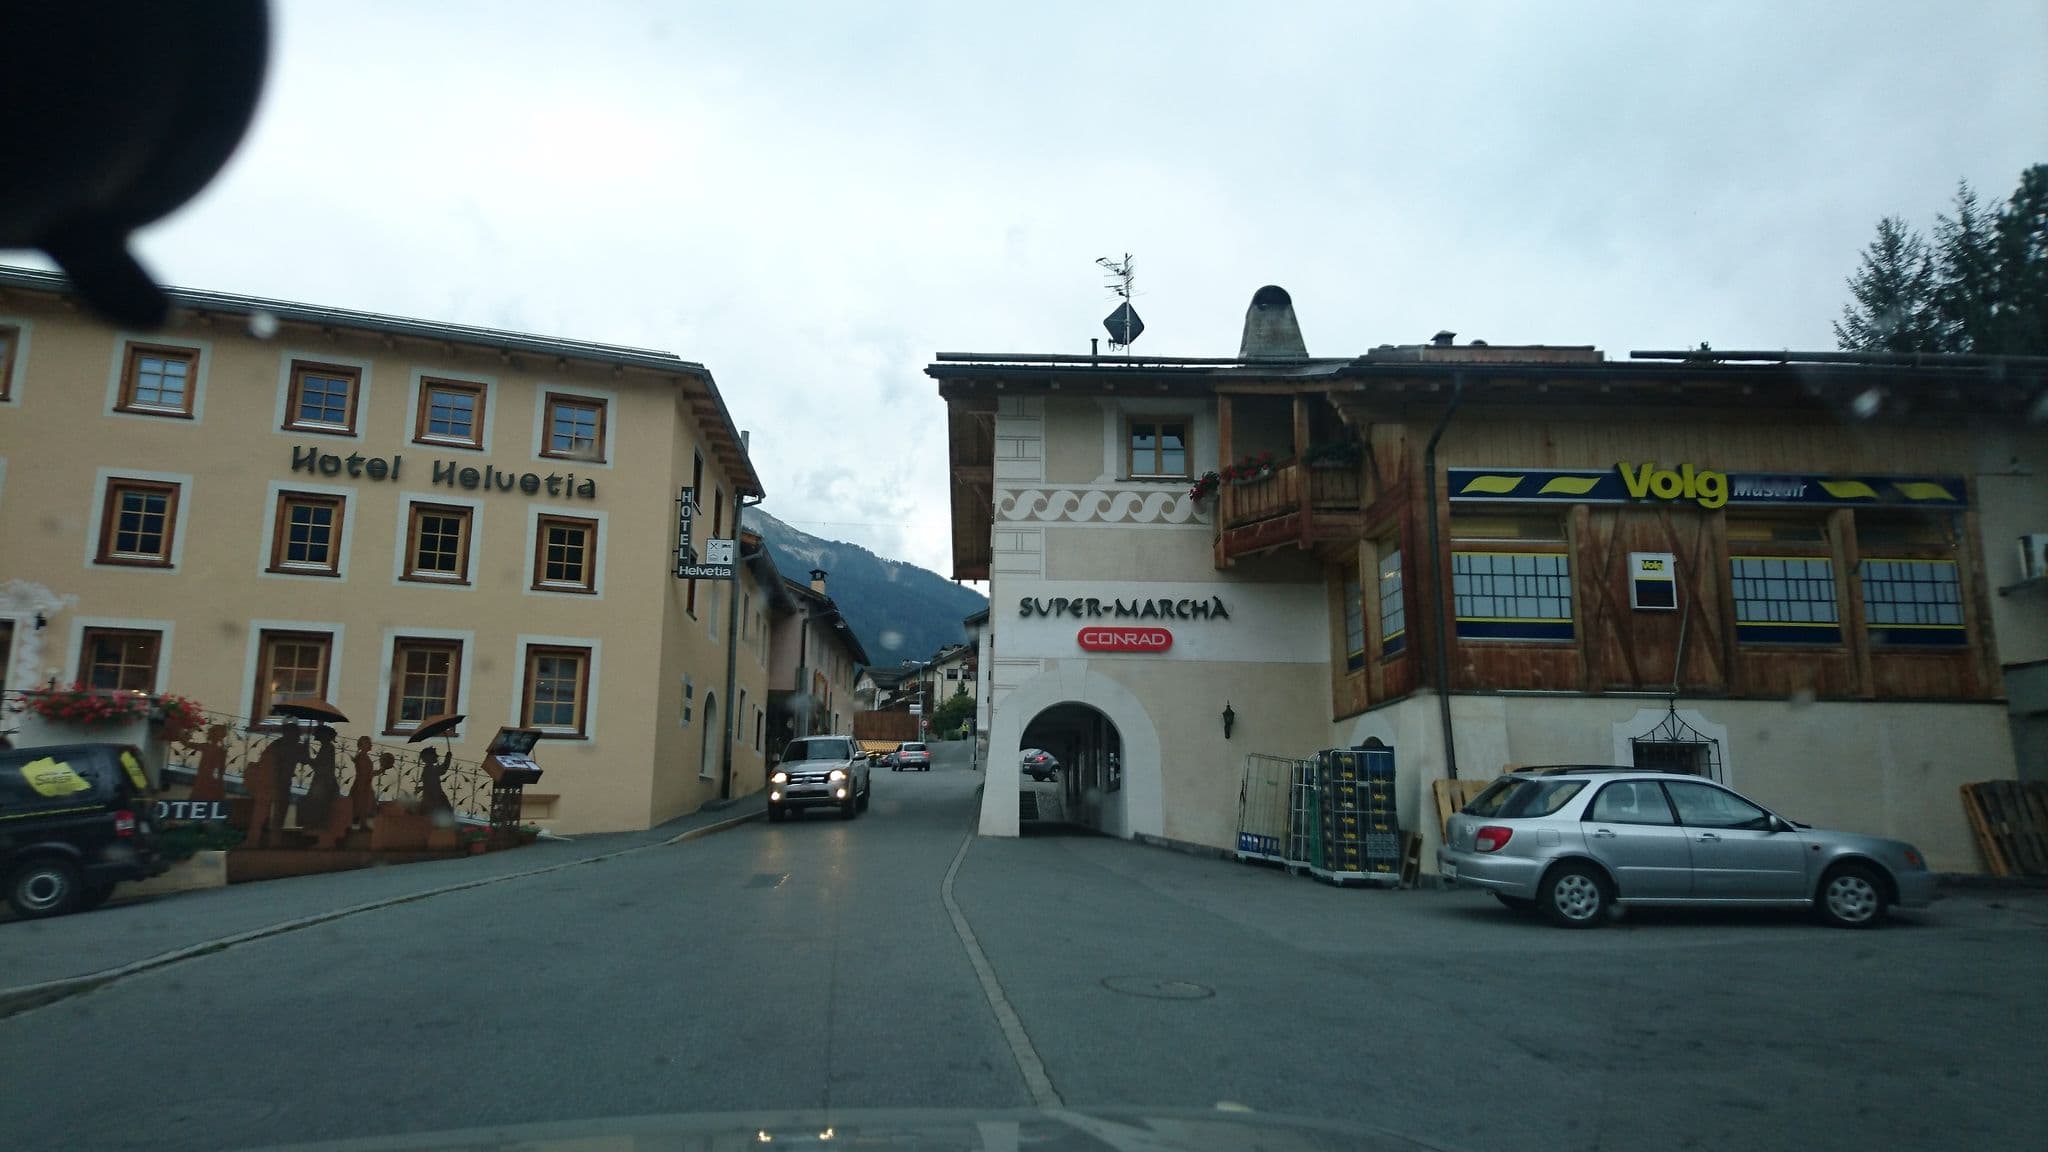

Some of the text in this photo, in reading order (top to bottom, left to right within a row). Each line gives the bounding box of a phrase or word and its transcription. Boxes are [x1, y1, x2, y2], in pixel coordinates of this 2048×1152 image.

[291, 445, 597, 498] Hotel Helvetia
[1616, 461, 1729, 510] Volg
[679, 491, 692, 560] HOTEL
[679, 565, 732, 577] Helvetia
[1018, 596, 1230, 619] SUPER-MARCHÀ
[1083, 632, 1166, 646] CONRAD
[157, 800, 229, 819] OTEL
